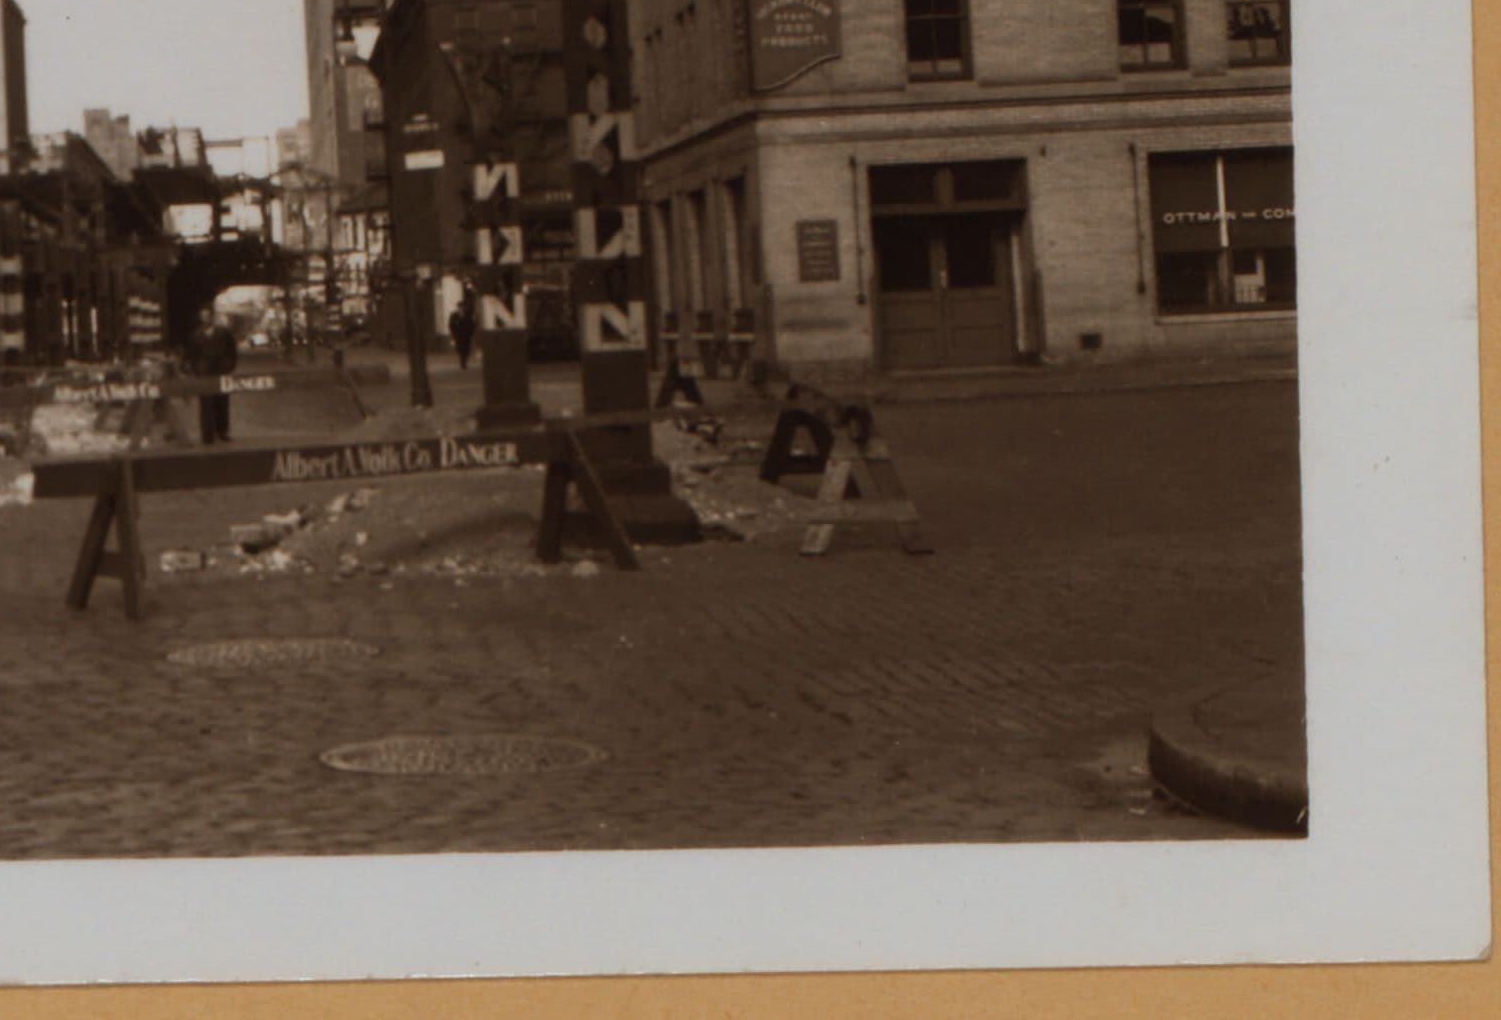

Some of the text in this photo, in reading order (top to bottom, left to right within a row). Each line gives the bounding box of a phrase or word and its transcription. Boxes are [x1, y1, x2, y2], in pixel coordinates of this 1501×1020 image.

[1163, 211, 1236, 224] OTTMAN
[272, 451, 338, 480] Albert
[439, 435, 519, 467] DANGER
